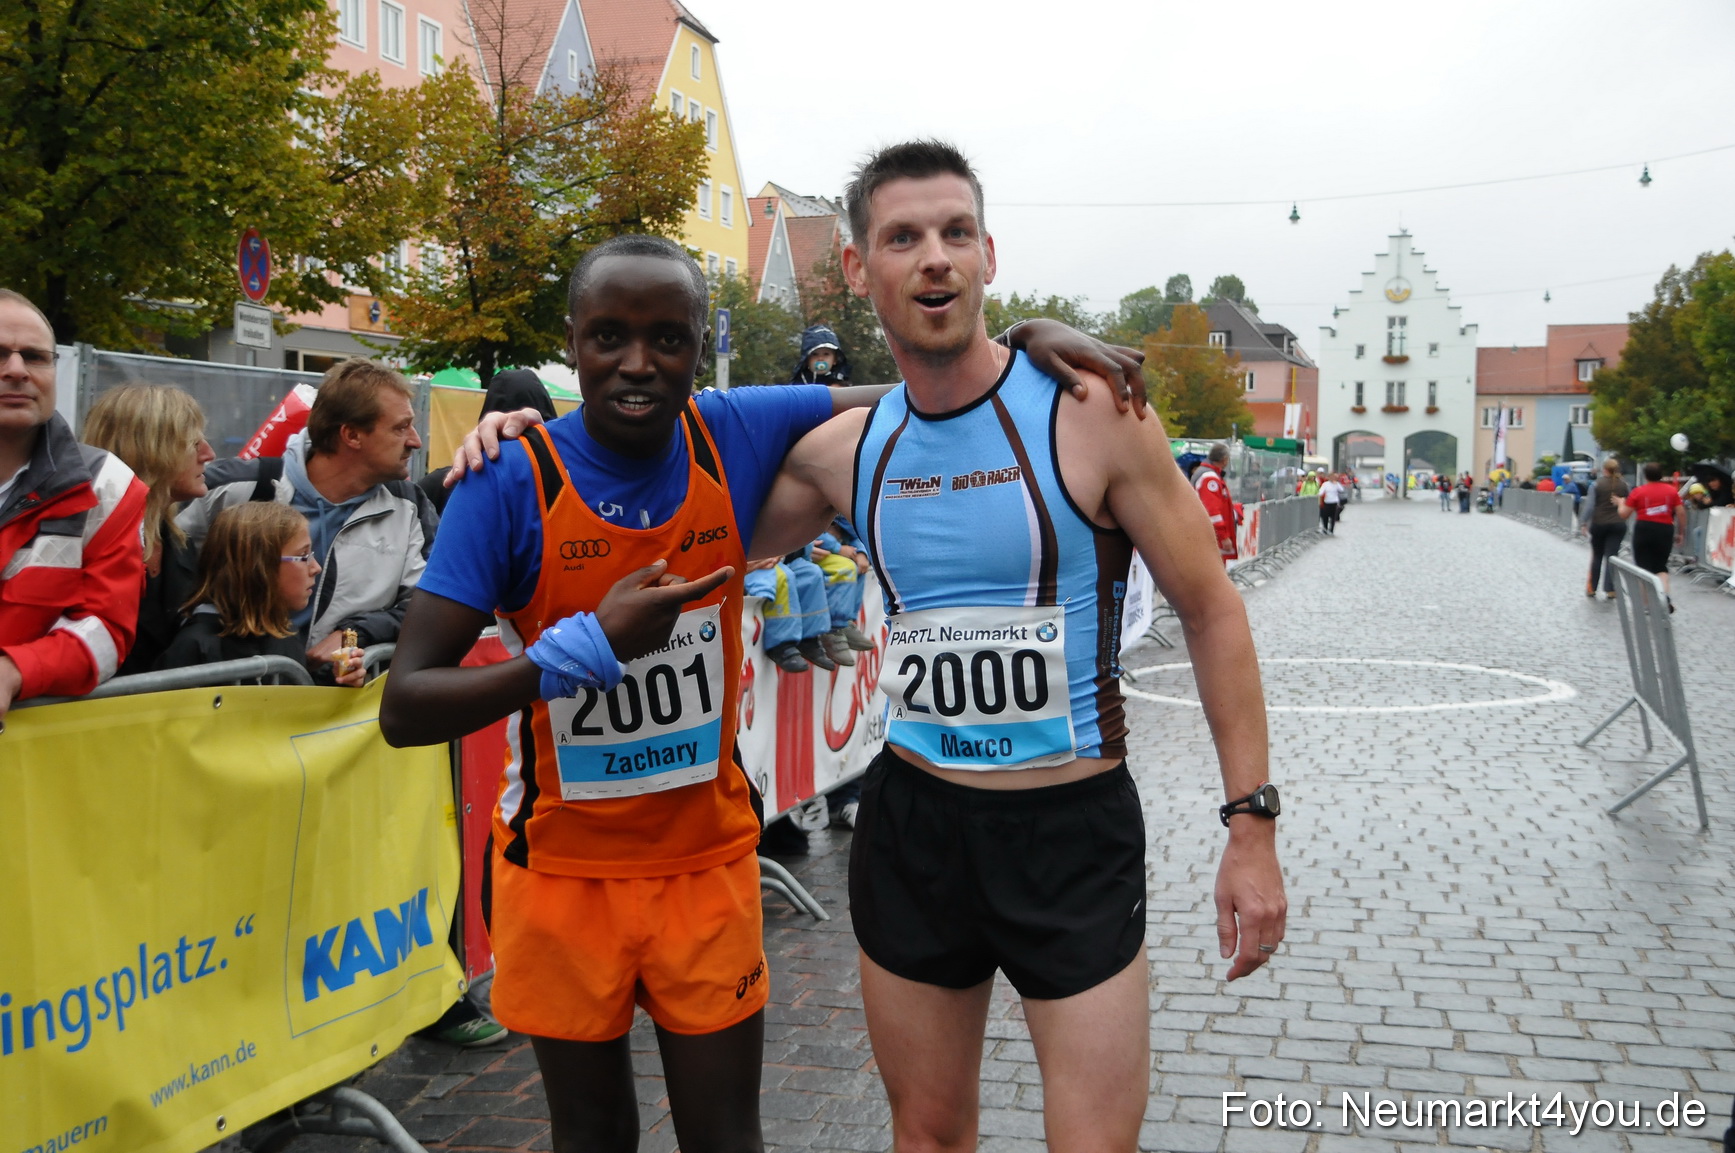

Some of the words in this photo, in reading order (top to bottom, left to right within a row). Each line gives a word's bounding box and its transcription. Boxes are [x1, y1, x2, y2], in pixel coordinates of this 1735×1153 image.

[718, 314, 728, 349] P
[697, 525, 728, 545] asics
[563, 563, 585, 572] Audi
[890, 628, 936, 646] PARTL
[940, 626, 1028, 642] Neumarkt
[566, 653, 713, 736] 2001
[898, 649, 1049, 717] 2000
[603, 741, 698, 775] Zachary
[940, 733, 1013, 758] Marco
[302, 886, 434, 1003] KANN
[150, 1039, 257, 1108] www.kann.de
